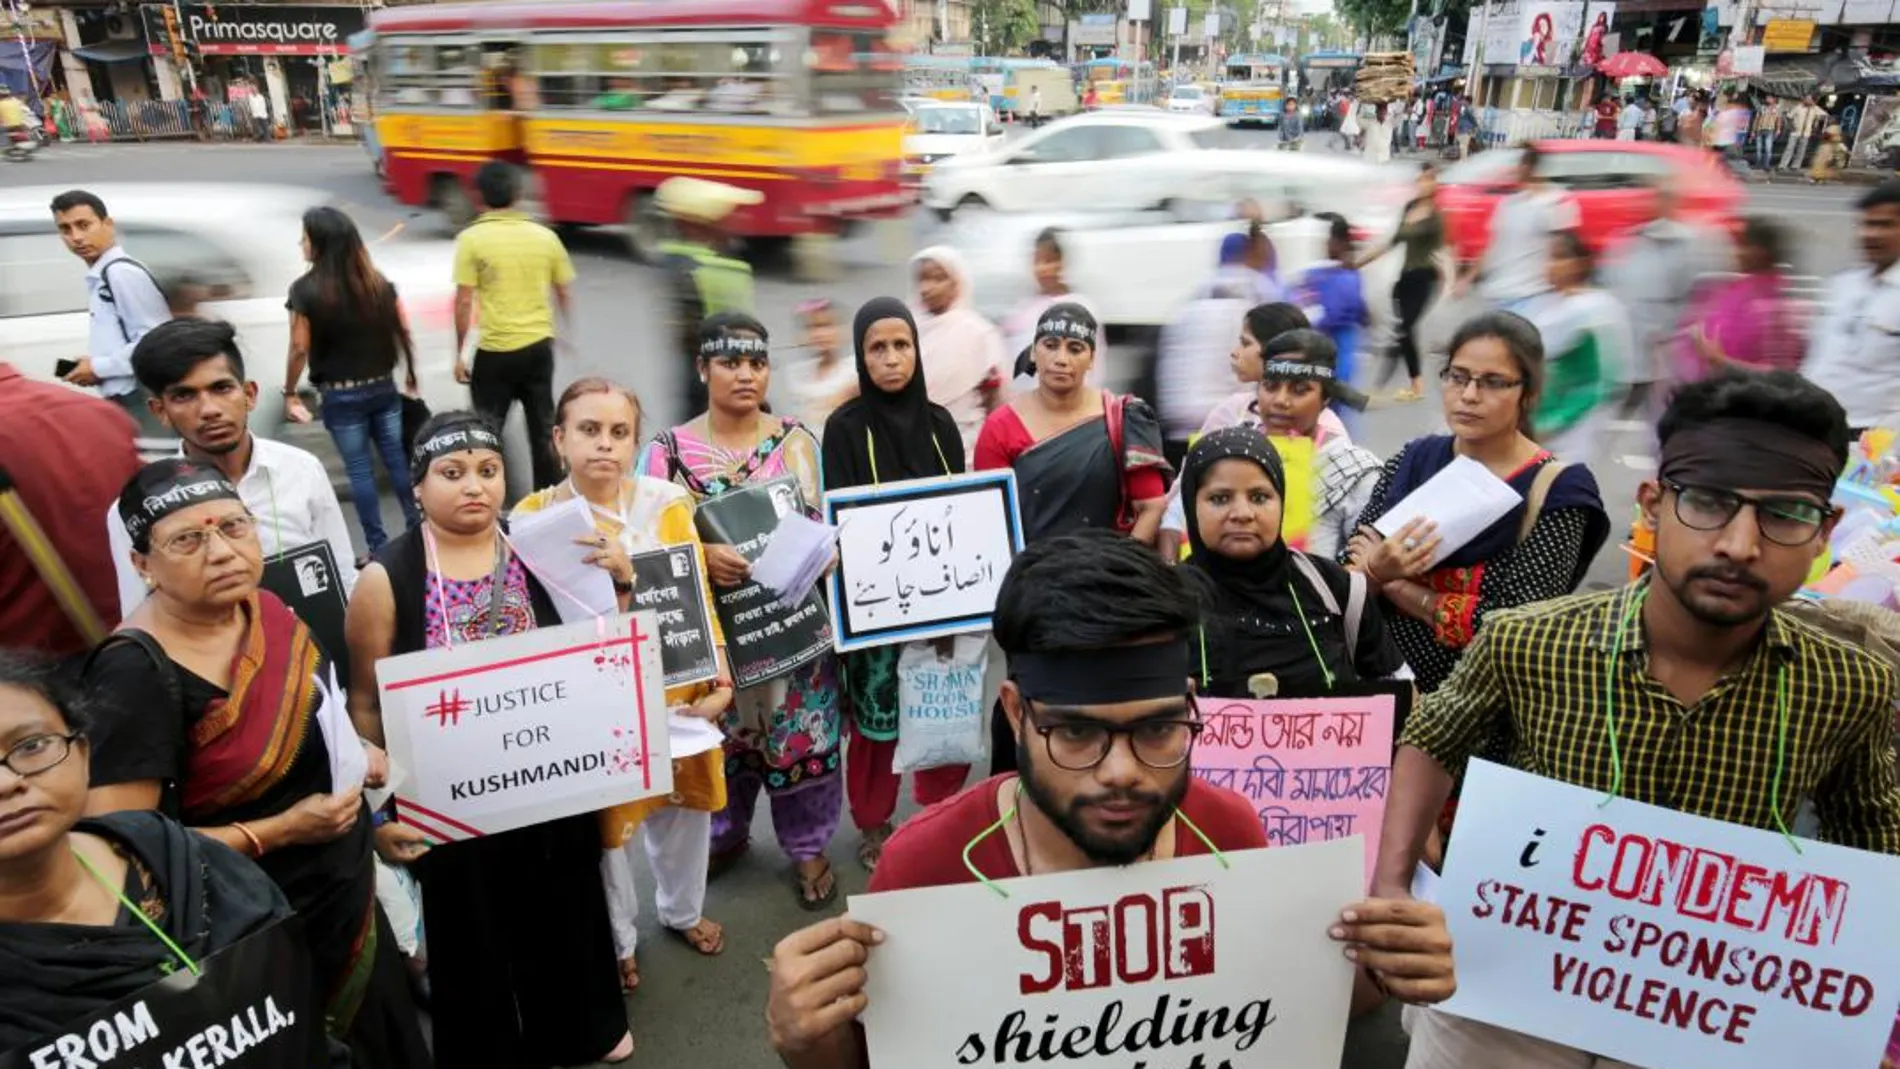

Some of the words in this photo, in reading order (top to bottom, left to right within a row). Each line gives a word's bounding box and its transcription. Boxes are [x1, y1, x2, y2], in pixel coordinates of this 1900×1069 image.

[190, 15, 338, 42] Primasquare
[919, 554, 993, 596] انصاف
[502, 724, 552, 751] FOR
[1262, 711, 1323, 750] আর
[1322, 712, 1372, 748] নয়
[450, 751, 606, 801] KUSHMANDI
[1572, 823, 1849, 946] CONDEMN
[1017, 882, 1216, 995] STOP
[1471, 878, 1592, 942] STATE
[1603, 914, 1876, 1018] SPONSORED
[161, 994, 296, 1069] KERALA,
[955, 993, 1278, 1066] shielding
[1552, 952, 1757, 1044] VIOLENCE
[28, 999, 161, 1069] FROM
